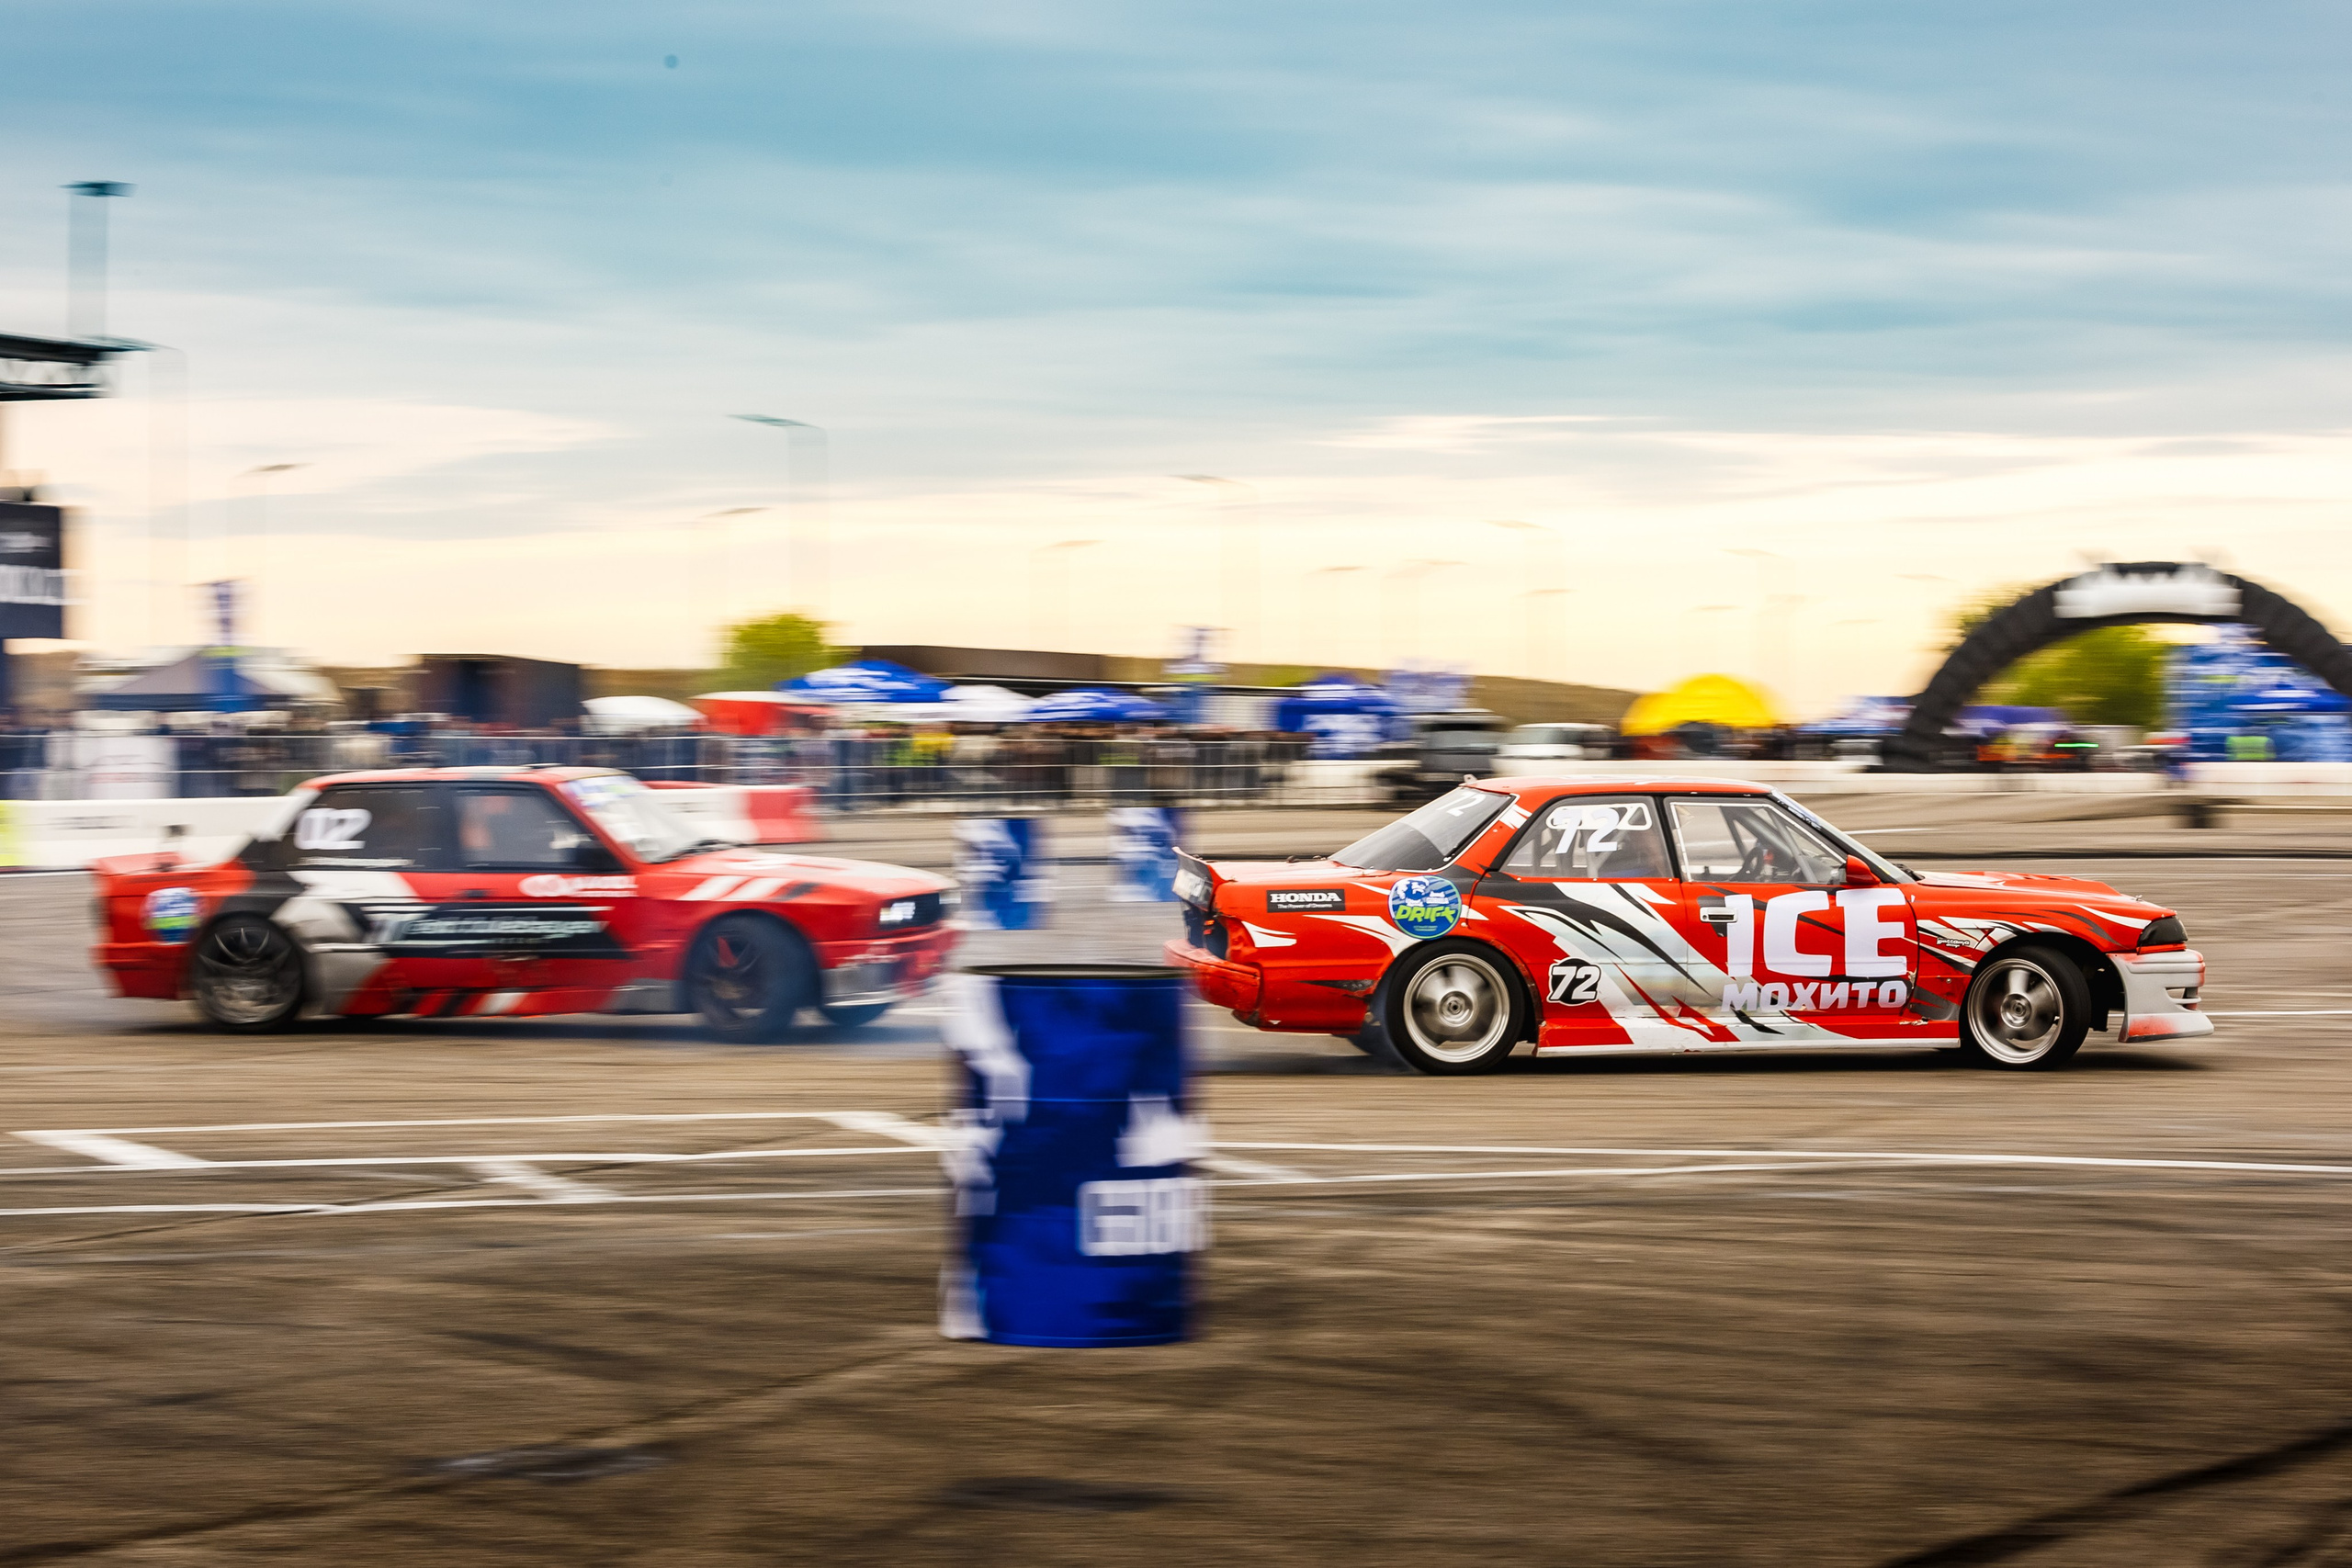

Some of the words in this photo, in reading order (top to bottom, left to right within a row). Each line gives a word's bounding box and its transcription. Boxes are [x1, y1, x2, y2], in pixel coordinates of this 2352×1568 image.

[294, 808, 372, 850] 02
[1554, 808, 1620, 854] 72
[1270, 892, 1342, 903] HONDA
[1395, 905, 1456, 923] DRIFT
[1724, 888, 1907, 977] ICE
[1548, 965, 1600, 1000] 72
[1722, 980, 1907, 1011] МОХИТО
